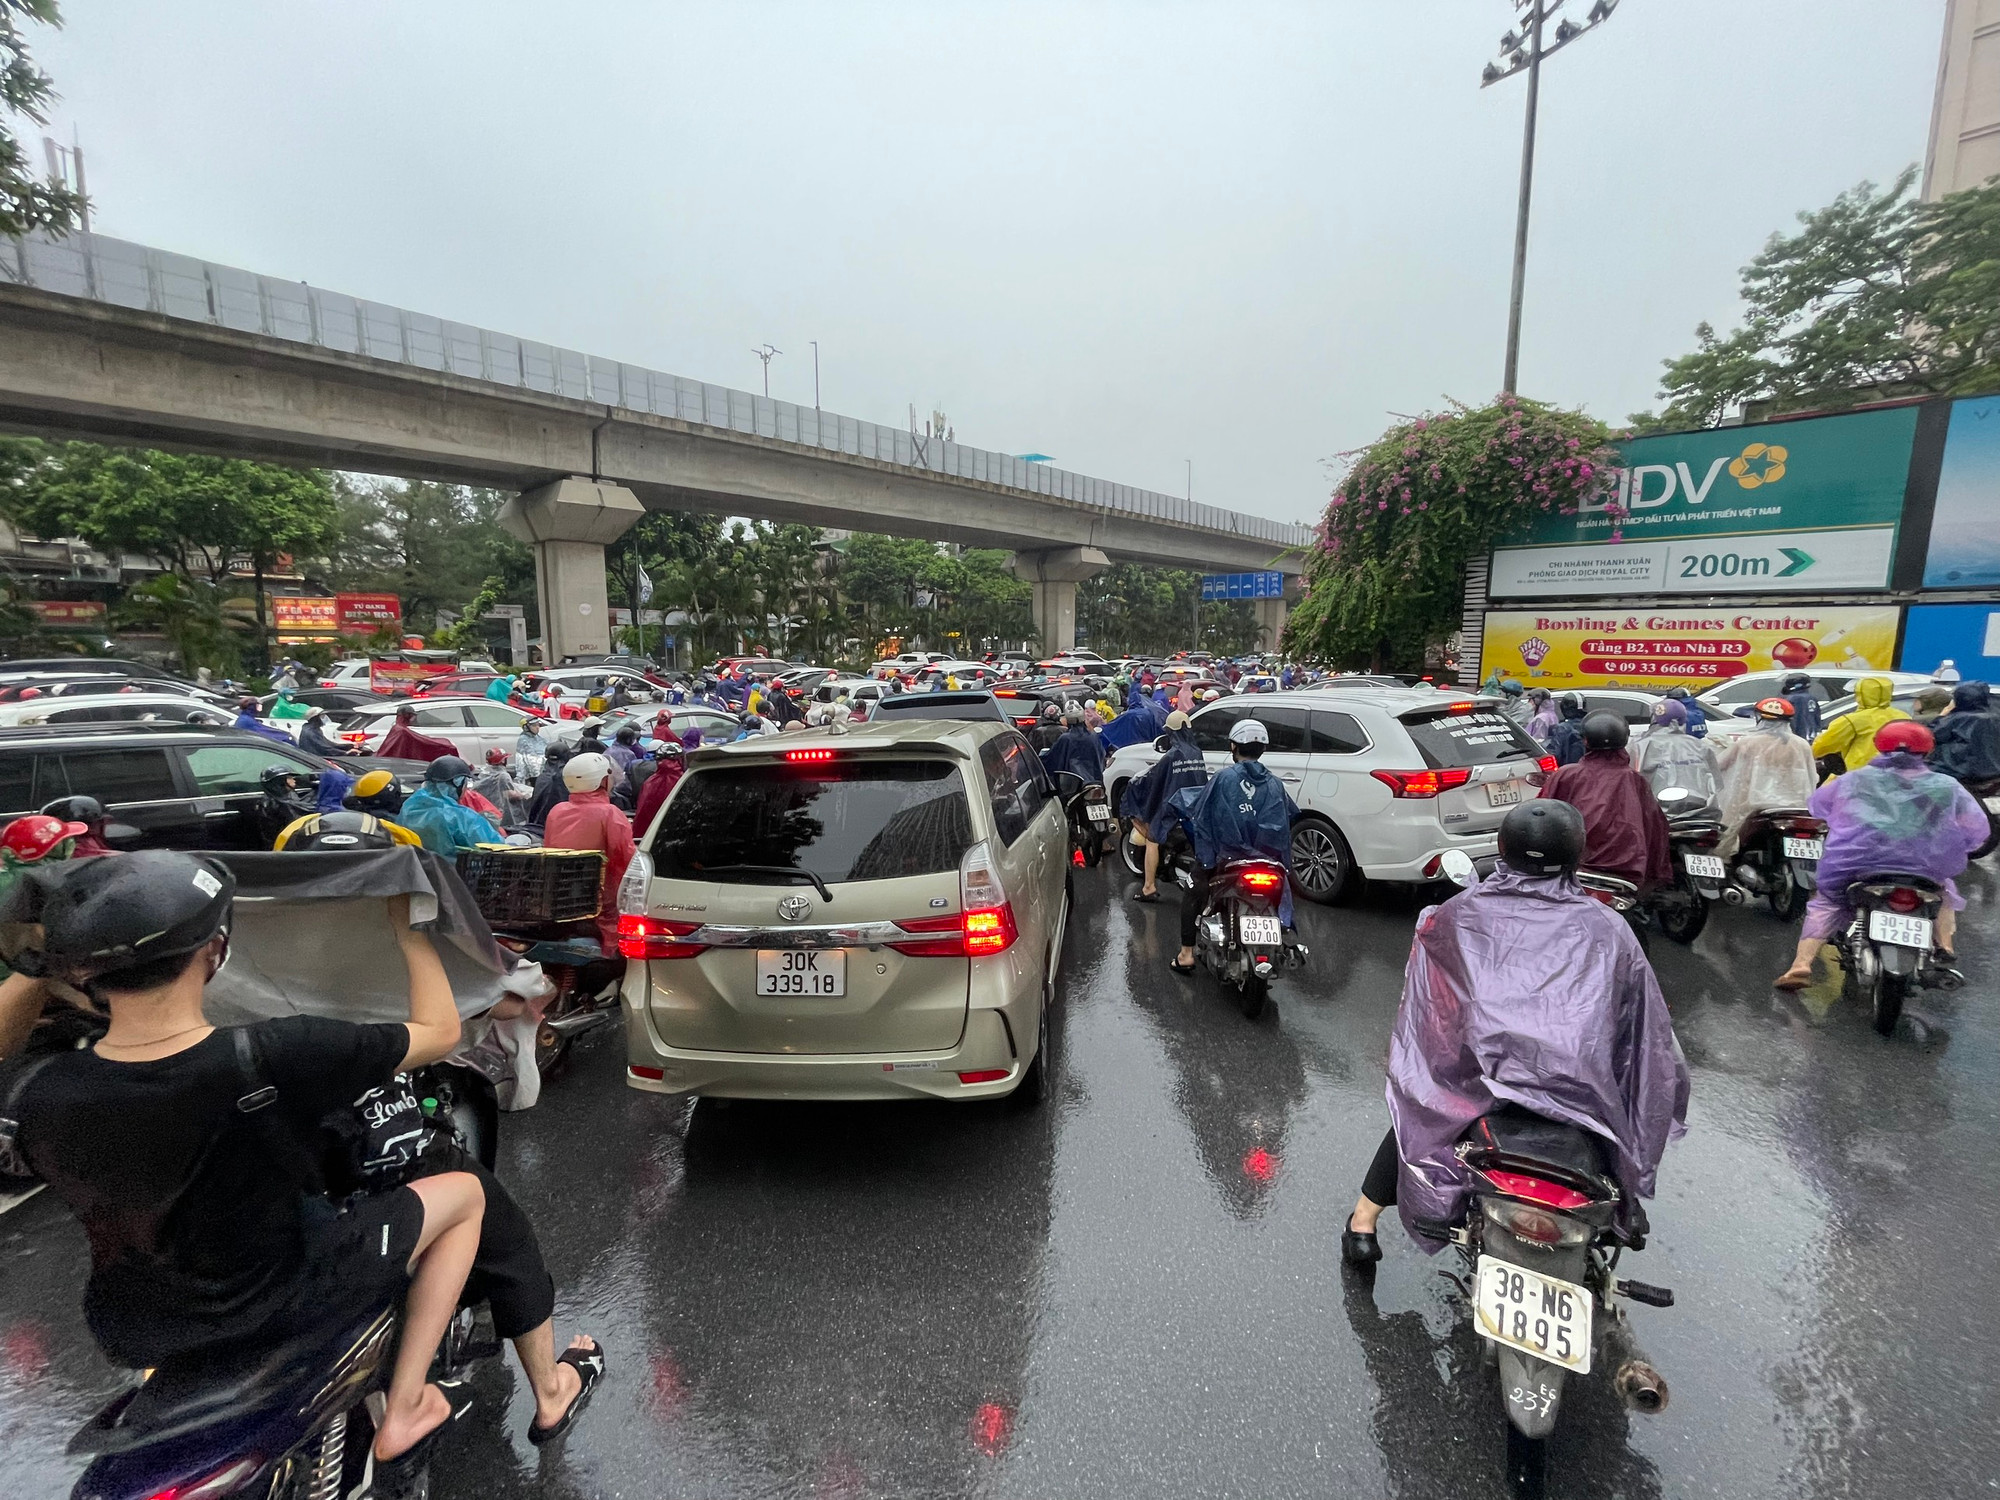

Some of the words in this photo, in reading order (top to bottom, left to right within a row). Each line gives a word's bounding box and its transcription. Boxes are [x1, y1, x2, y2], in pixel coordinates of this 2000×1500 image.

[1599, 517, 1620, 527] HÀG
[1622, 516, 1644, 526] TMCP
[1688, 509, 1711, 521] PHÁT
[1759, 506, 1782, 516] NAM
[1596, 559, 1625, 567] THANH
[1680, 553, 1770, 579] 200m
[1578, 569, 1598, 577] DỊCH
[1600, 568, 1628, 576] ROYAL
[1629, 567, 1650, 575] CITY
[1534, 616, 1617, 634] Bowling
[1622, 616, 1640, 631] &
[1645, 616, 1725, 631] Games
[1731, 614, 1820, 631] Center
[1627, 641, 1649, 655] B2,
[1653, 641, 1680, 655] Tòa
[1685, 641, 1717, 655] Nhà
[1721, 642, 1743, 655] R3
[1619, 662, 1636, 673] 09
[1640, 662, 1657, 673] 33
[1660, 663, 1695, 674] 6666
[1699, 663, 1718, 675] 55
[1690, 865, 1722, 877] 869.07
[1246, 918, 1274, 931] 29-G1
[1879, 915, 1924, 932] 30-L9
[1243, 930, 1279, 943] 907.00
[1879, 928, 1922, 945] 1286
[781, 952, 819, 972] 30K
[766, 974, 835, 994] 339.18
[1494, 1267, 1573, 1322] 38-N6
[1494, 1302, 1572, 1359] 1895
